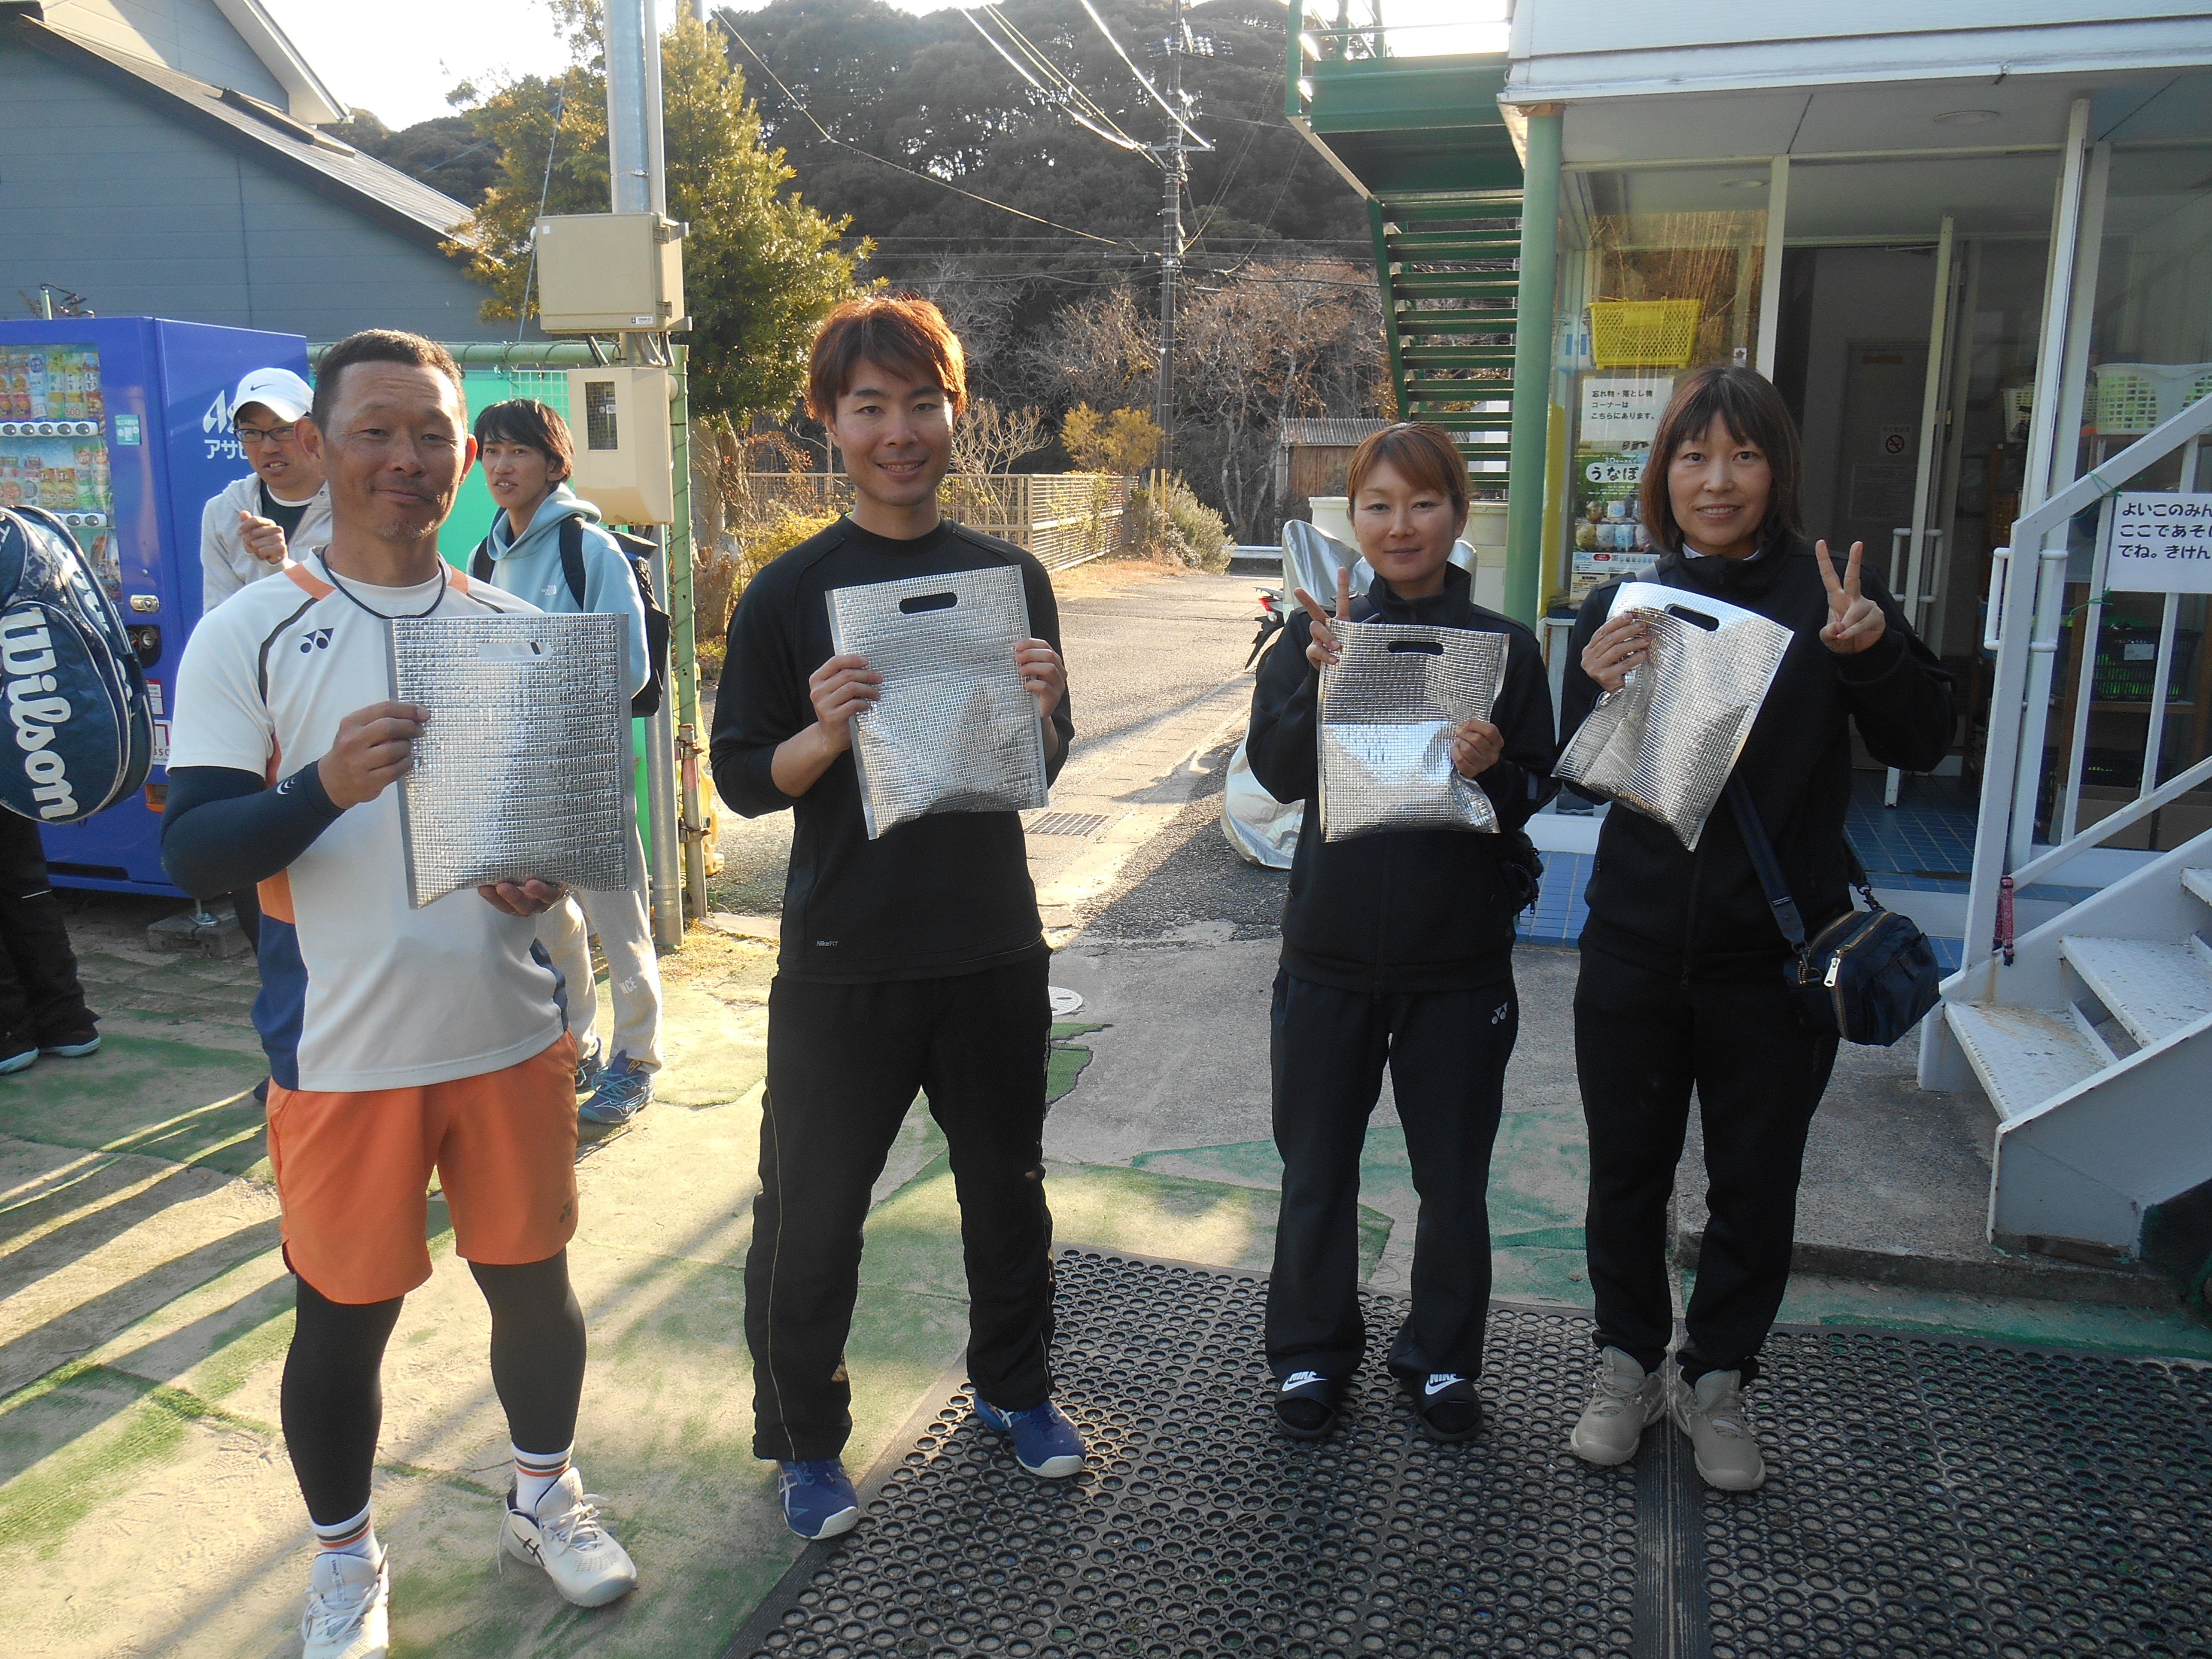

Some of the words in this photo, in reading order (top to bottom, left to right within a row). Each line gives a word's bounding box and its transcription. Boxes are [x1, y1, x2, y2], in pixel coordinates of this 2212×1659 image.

[1592, 466, 1639, 481] うなぽ
[2122, 503, 2212, 517] よいこのみん
[2120, 524, 2212, 538] ここであそ
[0, 607, 78, 819] Wilson
[617, 977, 637, 994] NCE
[1289, 1371, 1317, 1382] NIKE
[1430, 1373, 1456, 1384] NIKE
